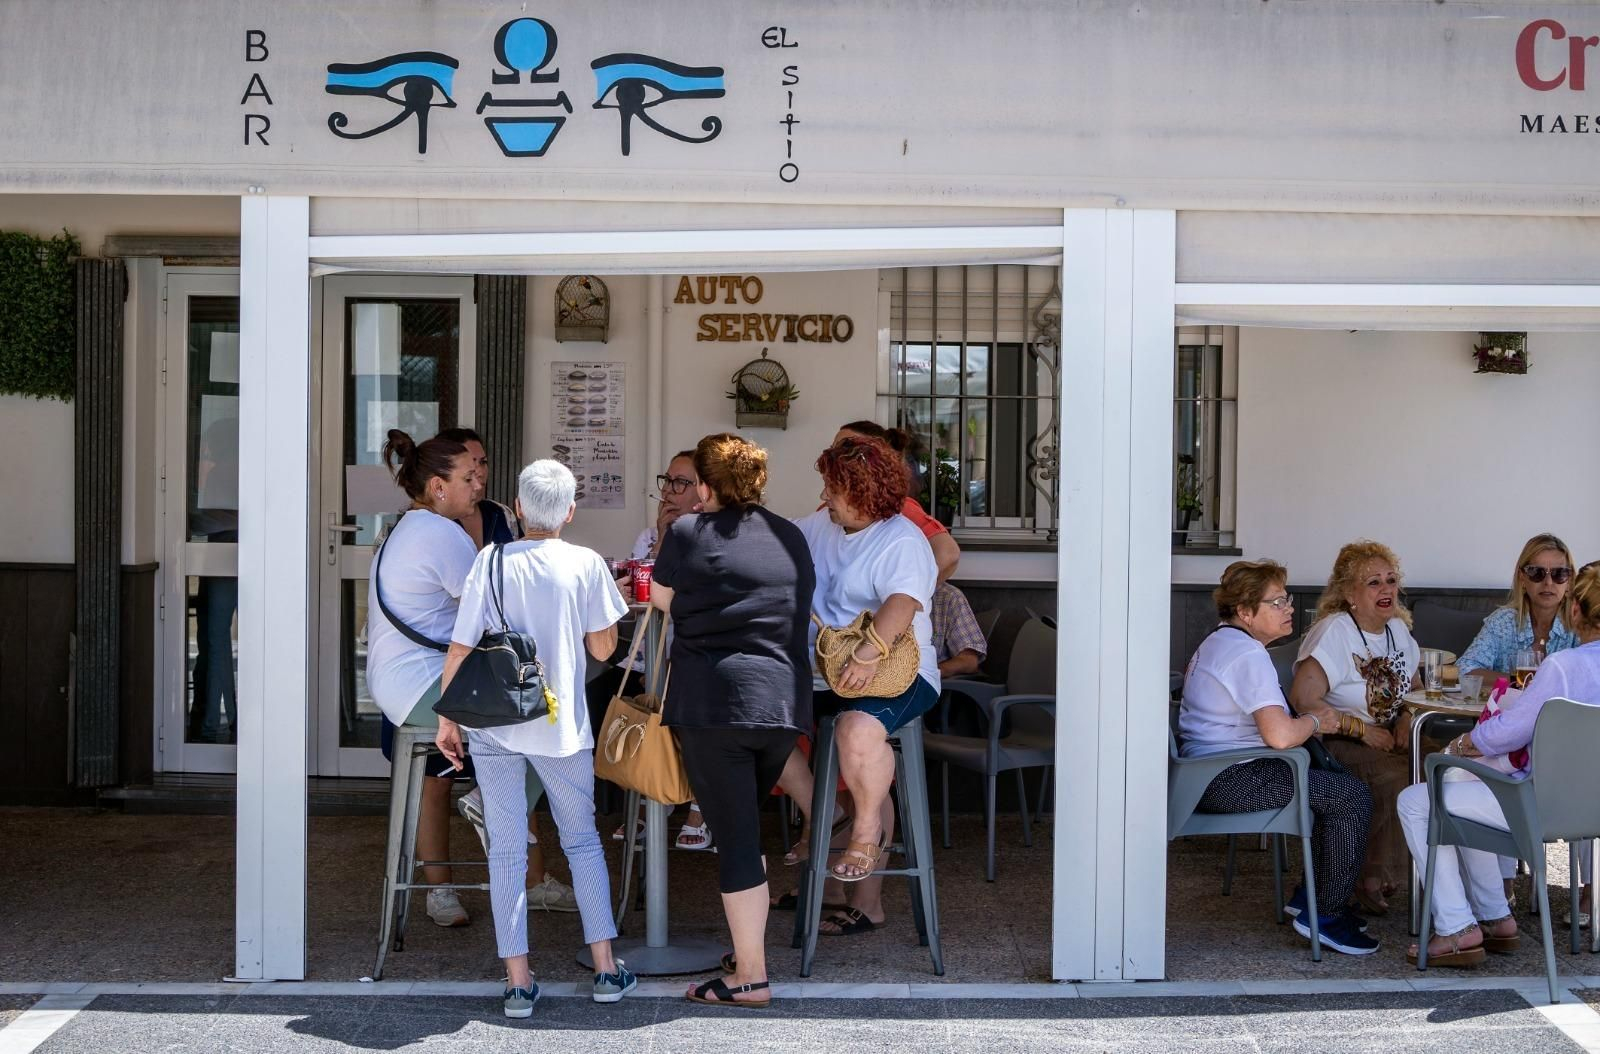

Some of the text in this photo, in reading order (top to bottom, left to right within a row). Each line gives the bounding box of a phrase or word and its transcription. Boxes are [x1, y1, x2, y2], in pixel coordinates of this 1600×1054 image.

[761, 26, 799, 49] EL
[1515, 18, 1600, 91] Cr
[240, 29, 273, 146] BAR
[673, 275, 764, 305] AUTO
[696, 313, 855, 343] SERVICIO
